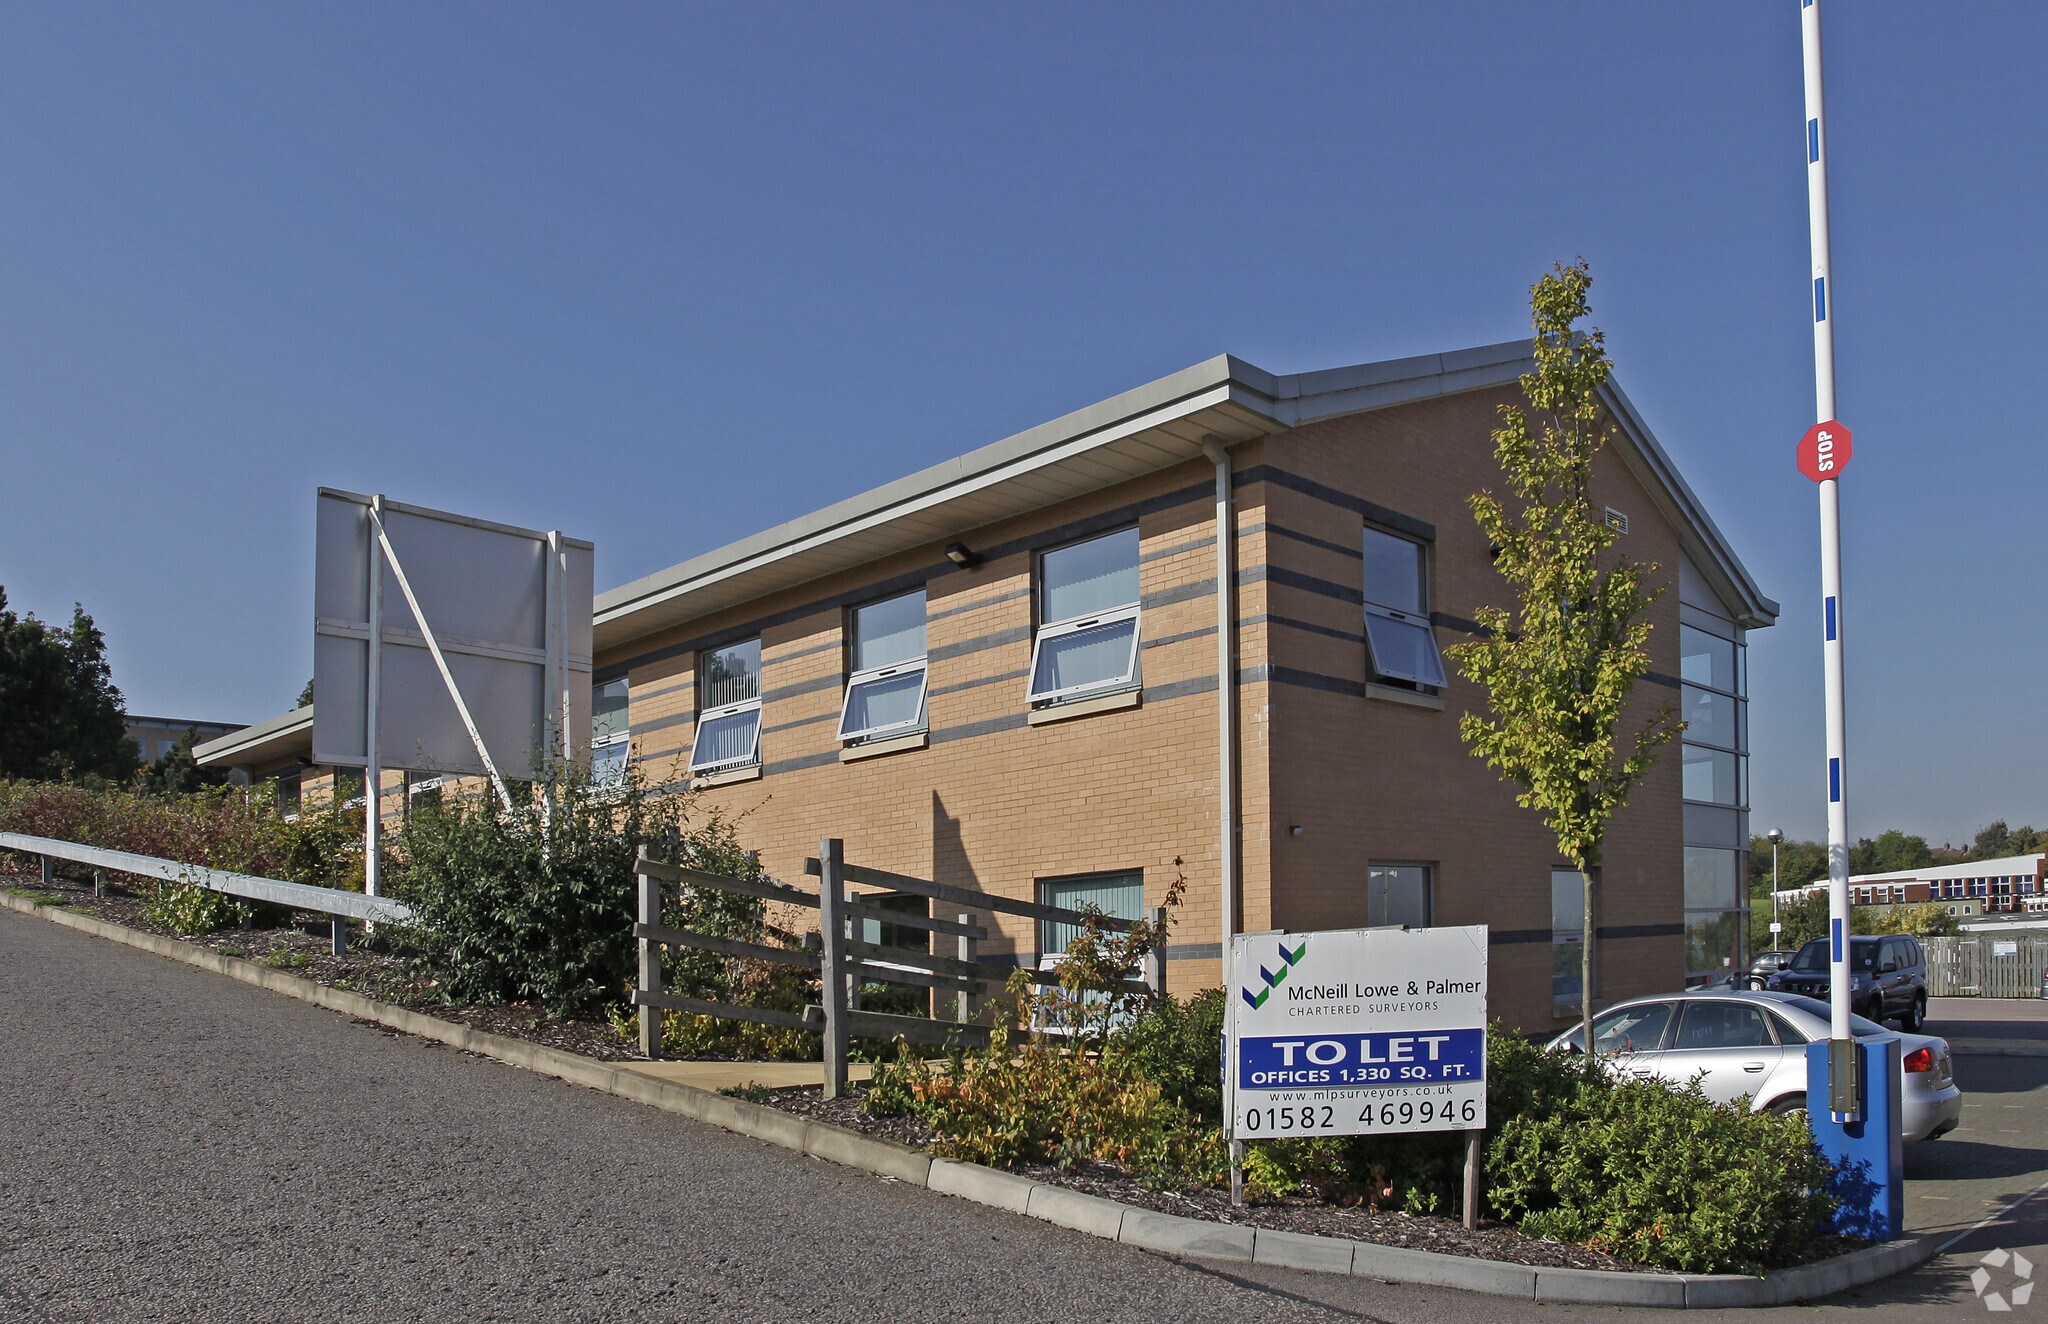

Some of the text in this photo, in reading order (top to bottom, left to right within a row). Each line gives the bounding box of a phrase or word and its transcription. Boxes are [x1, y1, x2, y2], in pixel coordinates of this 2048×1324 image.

[1817, 430, 1834, 472] STOP
[1288, 979, 1481, 1001] McNeill Lowe & Palmer
[1289, 1001, 1438, 1017] CHARTERED SURVEYORS
[1272, 1035, 1450, 1066] TO LET
[1251, 1064, 1470, 1084] OFFICES 1,330 SQ. FT.
[1269, 1084, 1453, 1102] www.mlpsurveyors.co.uk
[1246, 1099, 1476, 1131] 01582 469946
